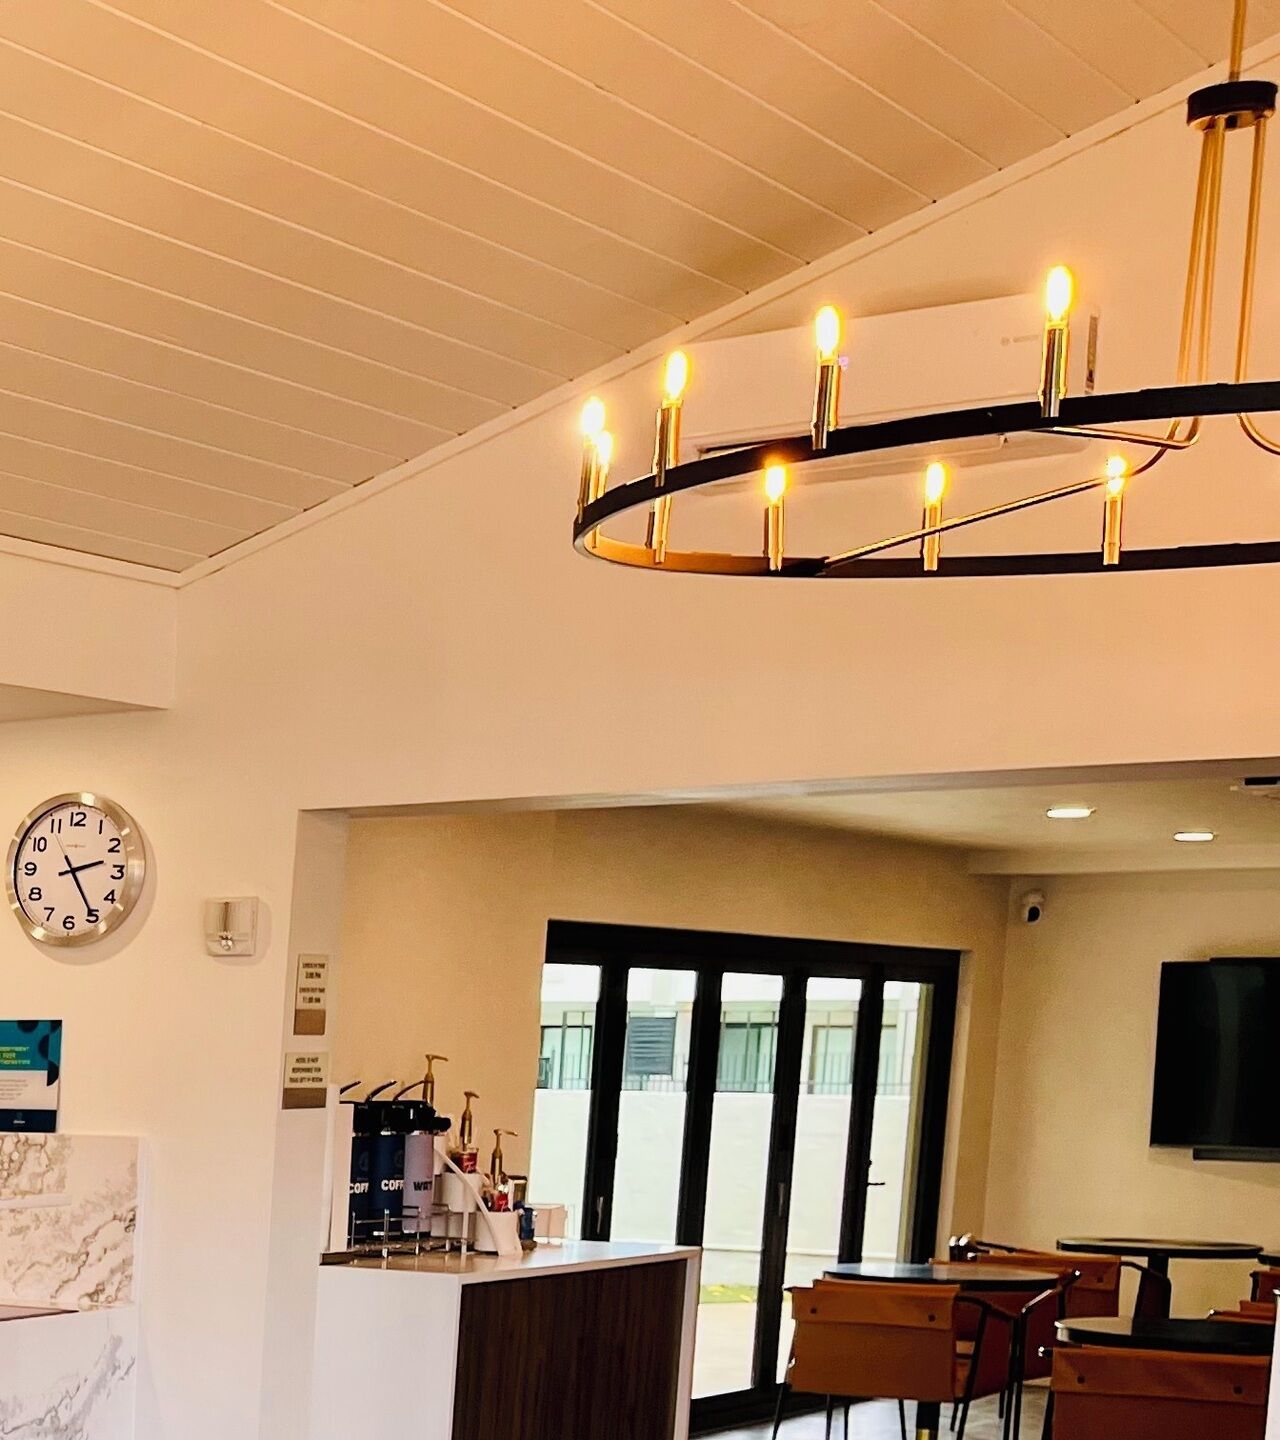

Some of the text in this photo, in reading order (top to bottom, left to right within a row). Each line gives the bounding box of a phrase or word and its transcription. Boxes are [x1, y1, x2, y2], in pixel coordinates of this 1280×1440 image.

[51, 818, 62, 834] 11
[70, 812, 87, 827] 12
[99, 819, 104, 835] 1
[33, 837, 47, 852] 10
[108, 838, 121, 853] 2
[24, 862, 37, 876] 9
[110, 864, 125, 880] 3
[28, 887, 42, 901] 8
[104, 889, 116, 904] 4
[44, 907, 55, 921] 7
[86, 909, 100, 924] 5
[62, 915, 75, 930] 6
[348, 1182, 370, 1194] COFF
[381, 1179, 404, 1191] COFF
[413, 1181, 433, 1191] WAT
